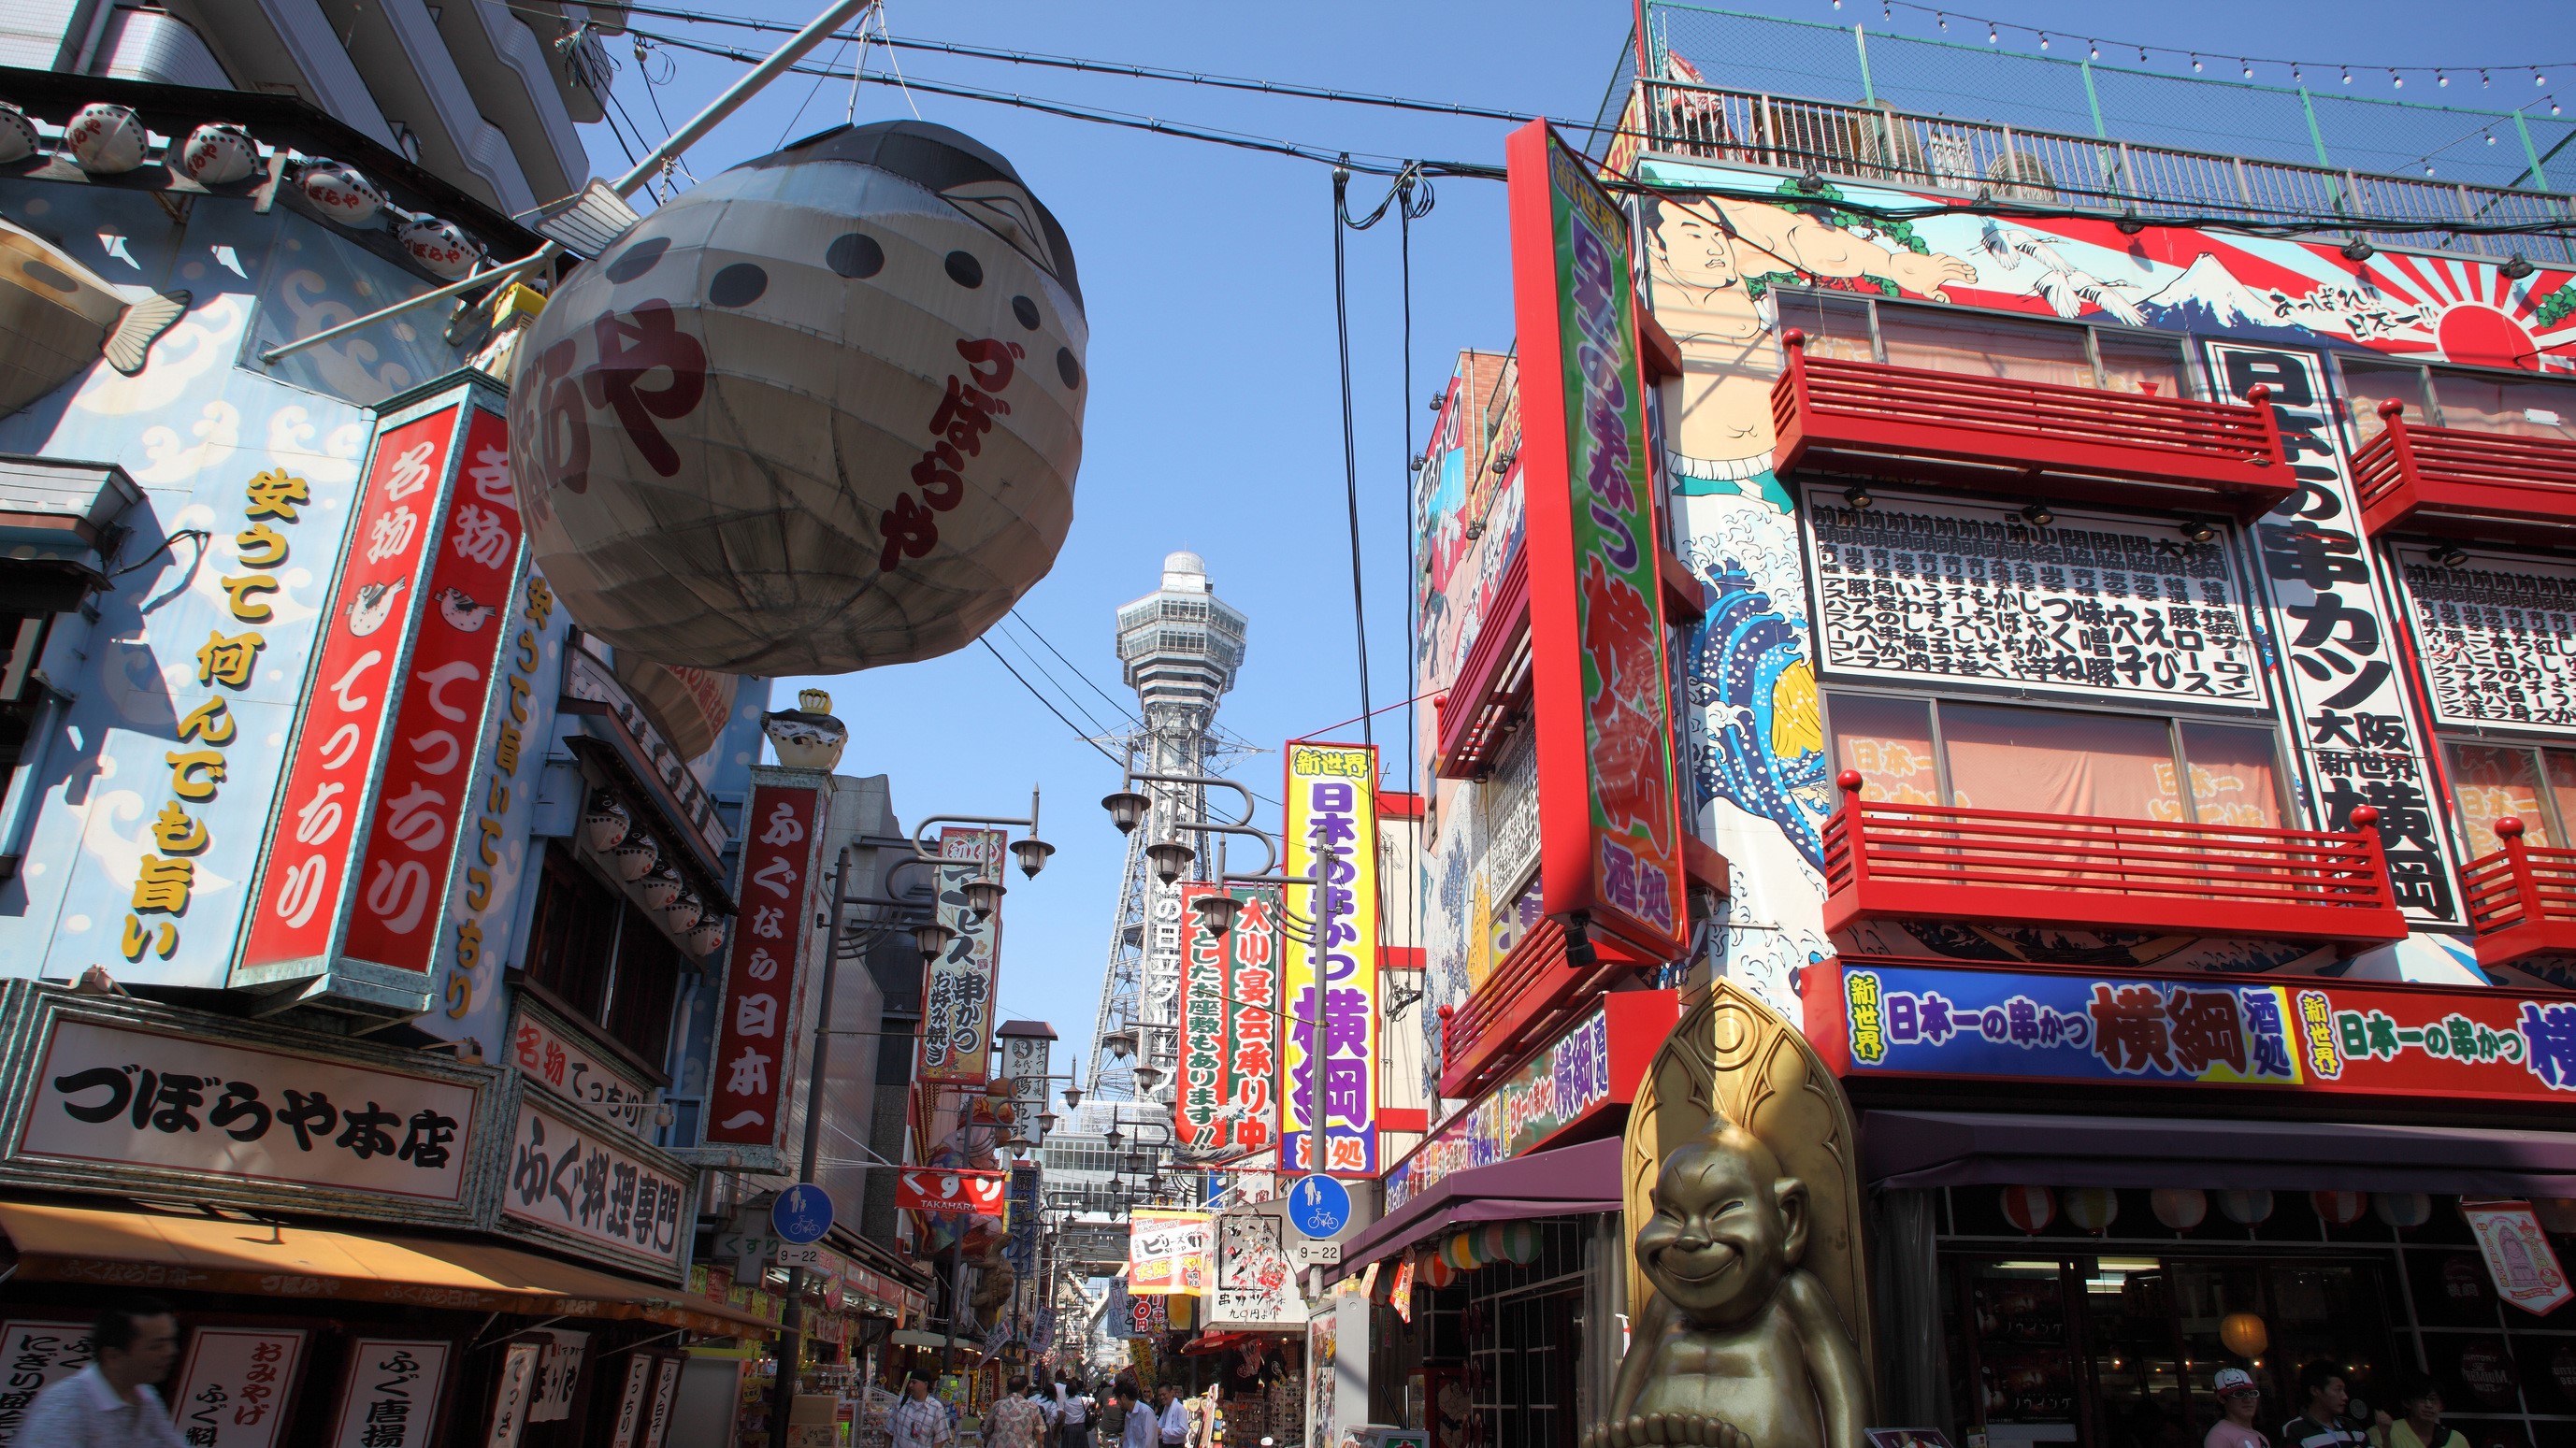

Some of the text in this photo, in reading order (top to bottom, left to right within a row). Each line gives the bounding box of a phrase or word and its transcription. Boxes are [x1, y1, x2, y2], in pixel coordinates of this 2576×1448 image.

[1550, 146, 1624, 259] 新世界
[880, 337, 1025, 572] づぼらや
[1293, 749, 1368, 778] 新世界
[2307, 709, 2411, 753] 大阪
[2318, 752, 2420, 782] 新世界
[276, 649, 383, 928] てっちり
[367, 660, 480, 935] てっちり
[1601, 837, 1674, 934] 酒処
[723, 802, 804, 1130] ふぐなら日本一
[926, 968, 954, 1065] お好み焼き
[952, 971, 987, 1054] 串かつ
[1848, 972, 1881, 1063] 新世界
[1885, 995, 2091, 1060] 日本一の串かつ
[2090, 983, 2246, 1076] 横綱
[2245, 990, 2292, 1078] 酒処
[2300, 993, 2340, 1079] 新世界
[2339, 1013, 2524, 1063] 日本一の串かつ
[54, 1064, 459, 1169] づぼらや本店
[515, 1023, 642, 1128] 名物 てっちり
[1553, 1021, 1594, 1125] 横綱
[512, 1115, 685, 1256] ふぐ料理専門
[902, 1170, 1001, 1202] くすり
[920, 1198, 978, 1212] TAKAHARA
[60, 1261, 208, 1285] ふぐなら日本一
[726, 1237, 779, 1255] くすり
[781, 1250, 817, 1262] 9-22
[1300, 1247, 1338, 1259] 9-22
[234, 1342, 282, 1426] おみやげ
